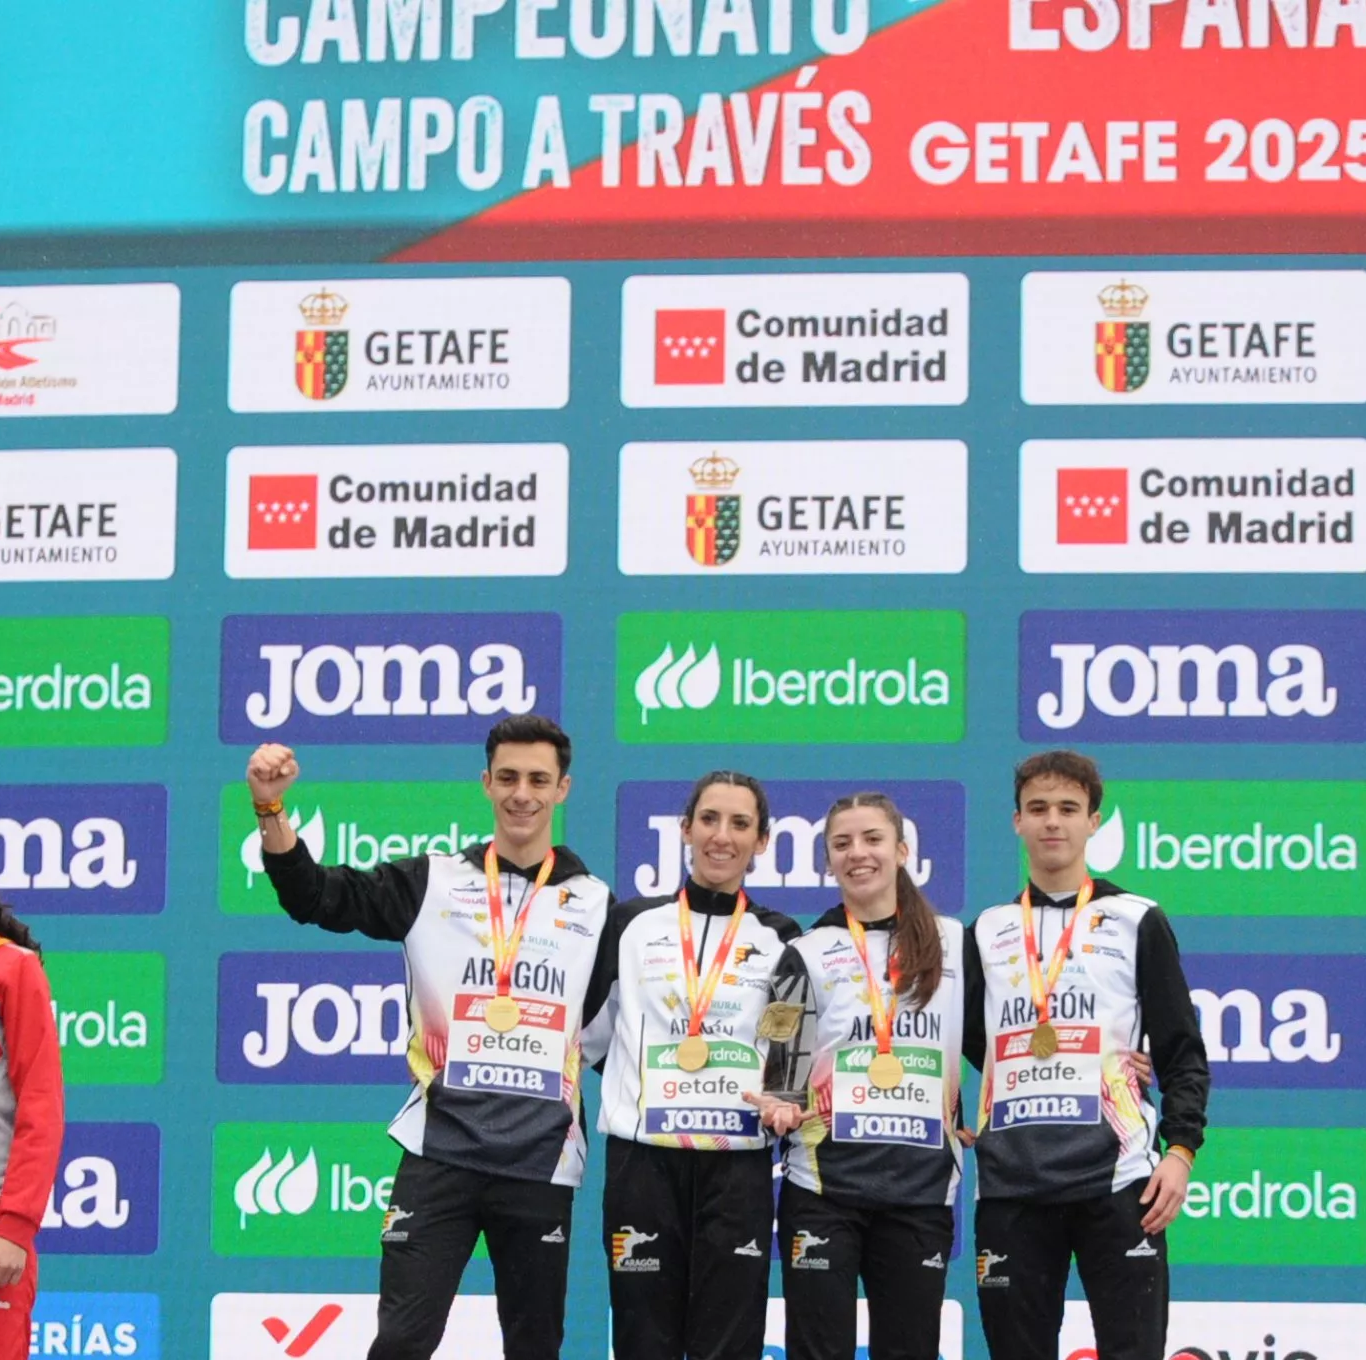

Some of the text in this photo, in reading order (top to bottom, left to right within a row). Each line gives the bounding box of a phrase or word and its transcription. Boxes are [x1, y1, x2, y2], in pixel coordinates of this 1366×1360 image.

[242, 95, 504, 195] CAMPO
[522, 95, 571, 189] A
[589, 65, 872, 188] TRAVÉS
[909, 120, 1178, 186] GETAFE
[736, 308, 949, 340] Comunidad
[1166, 322, 1317, 359] GETAFE
[365, 329, 510, 366] GETAFE
[366, 371, 510, 393] AYUNTAMIENTO
[736, 350, 947, 385] de Madrid
[1169, 365, 1317, 386] AYUNTAMIENTO
[329, 473, 537, 504] Comunidad
[1139, 468, 1355, 499] Comunidad
[757, 495, 906, 532] GETAFE
[1140, 511, 1355, 545] de Madrid
[328, 516, 536, 550] de Madrid
[759, 538, 907, 558] AYUNTAMIENTO
[246, 642, 536, 729] Joma
[733, 656, 950, 708] Iberdrola
[1038, 643, 1337, 730] Joma
[1137, 822, 1357, 870] Iberdrola
[462, 956, 565, 997] ARGÓN
[467, 1033, 548, 1056] getafe.
[463, 1063, 544, 1091] Joma
[1006, 1060, 1082, 1091] getafe.
[661, 1110, 743, 1133] Joma
[850, 1114, 928, 1140] Joma
[1004, 1096, 1081, 1124] Joma
[1181, 1170, 1357, 1219] erdrola
